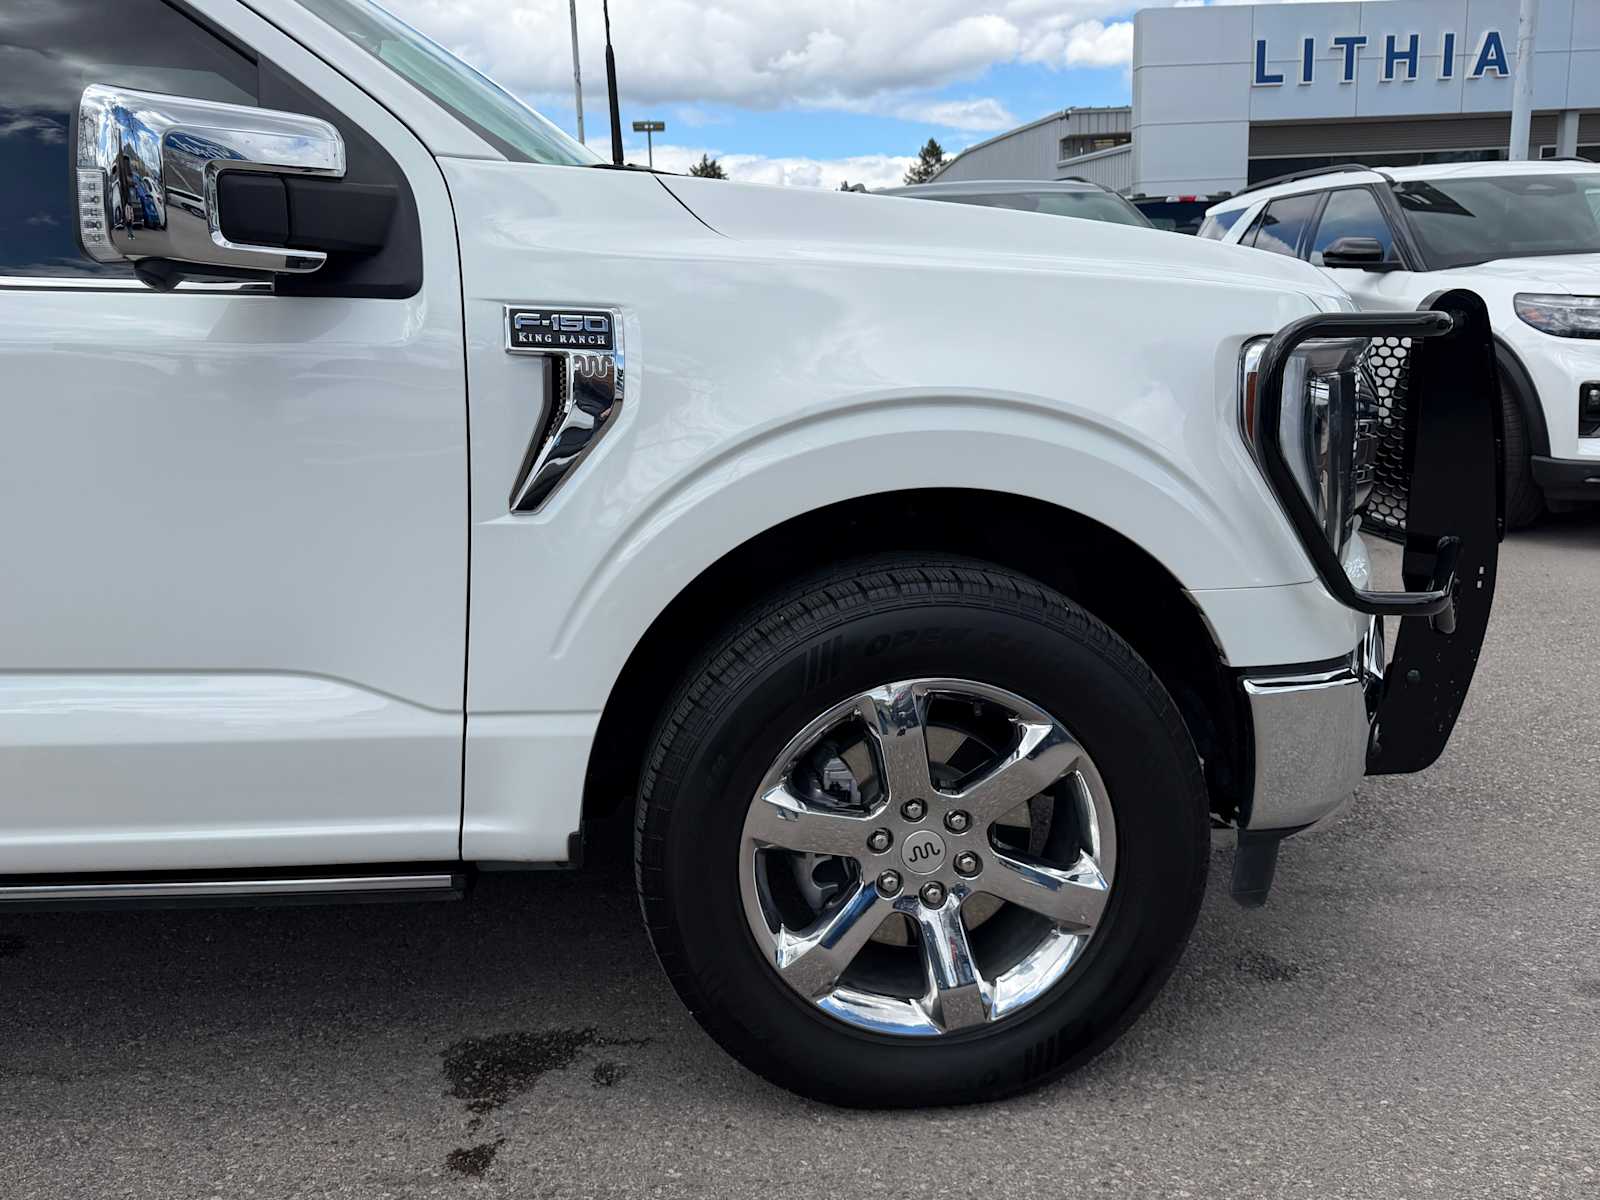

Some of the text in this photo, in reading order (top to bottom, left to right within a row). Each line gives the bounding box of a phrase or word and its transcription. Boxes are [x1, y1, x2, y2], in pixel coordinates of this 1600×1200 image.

[1254, 31, 1510, 85] LITHIA
[514, 312, 609, 332] F-150
[518, 332, 606, 345] KING RANCH
